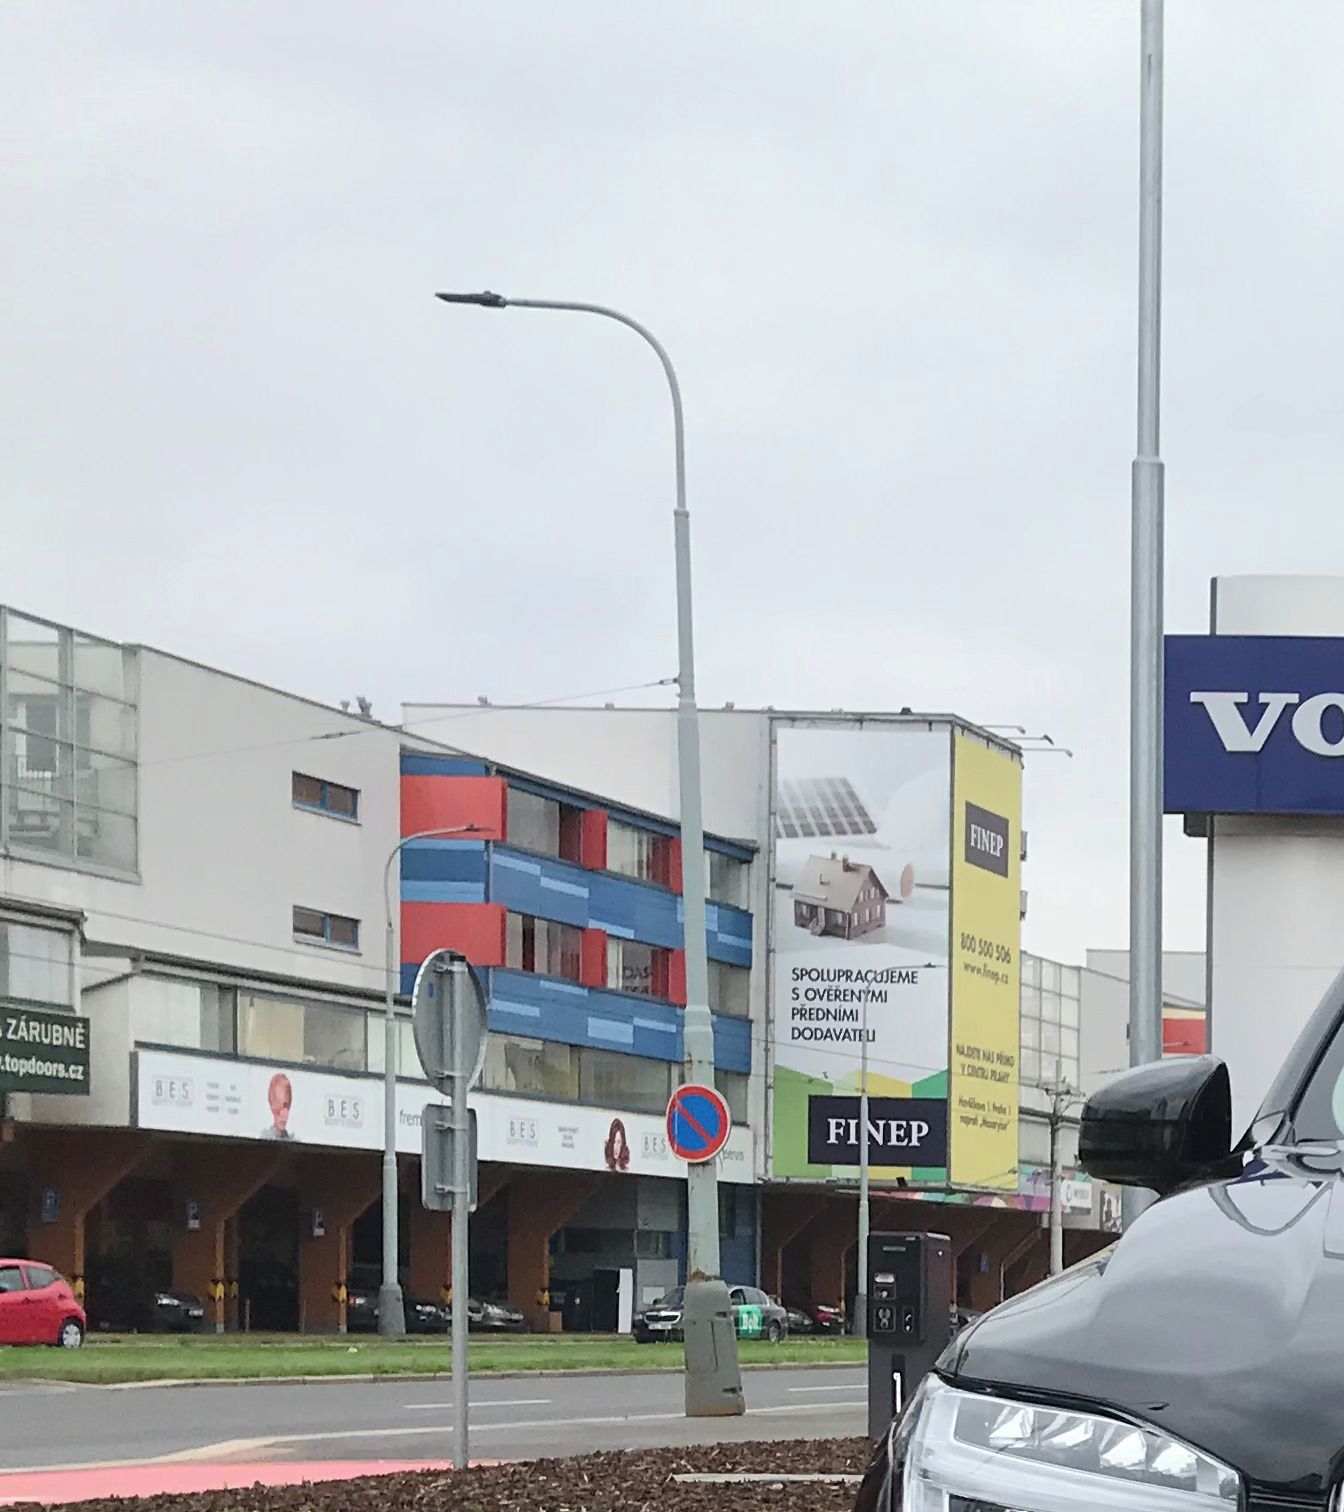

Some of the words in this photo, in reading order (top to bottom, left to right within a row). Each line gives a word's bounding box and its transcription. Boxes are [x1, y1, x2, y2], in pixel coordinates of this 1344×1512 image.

[970, 824, 1004, 857] FINEP
[960, 932, 976, 953] 800
[978, 938, 994, 959] 500
[996, 944, 1012, 965] 506
[791, 967, 919, 984] SPOLUPRACUJEME
[791, 987, 800, 1001] S
[791, 1004, 859, 1022] PŘEDNÍMI
[6, 1015, 86, 1049] ZÁRUBNĚ
[791, 1027, 876, 1042] DODAVATELI
[0, 1052, 84, 1080] .topdoors.cz
[826, 1118, 930, 1147] FINEP
